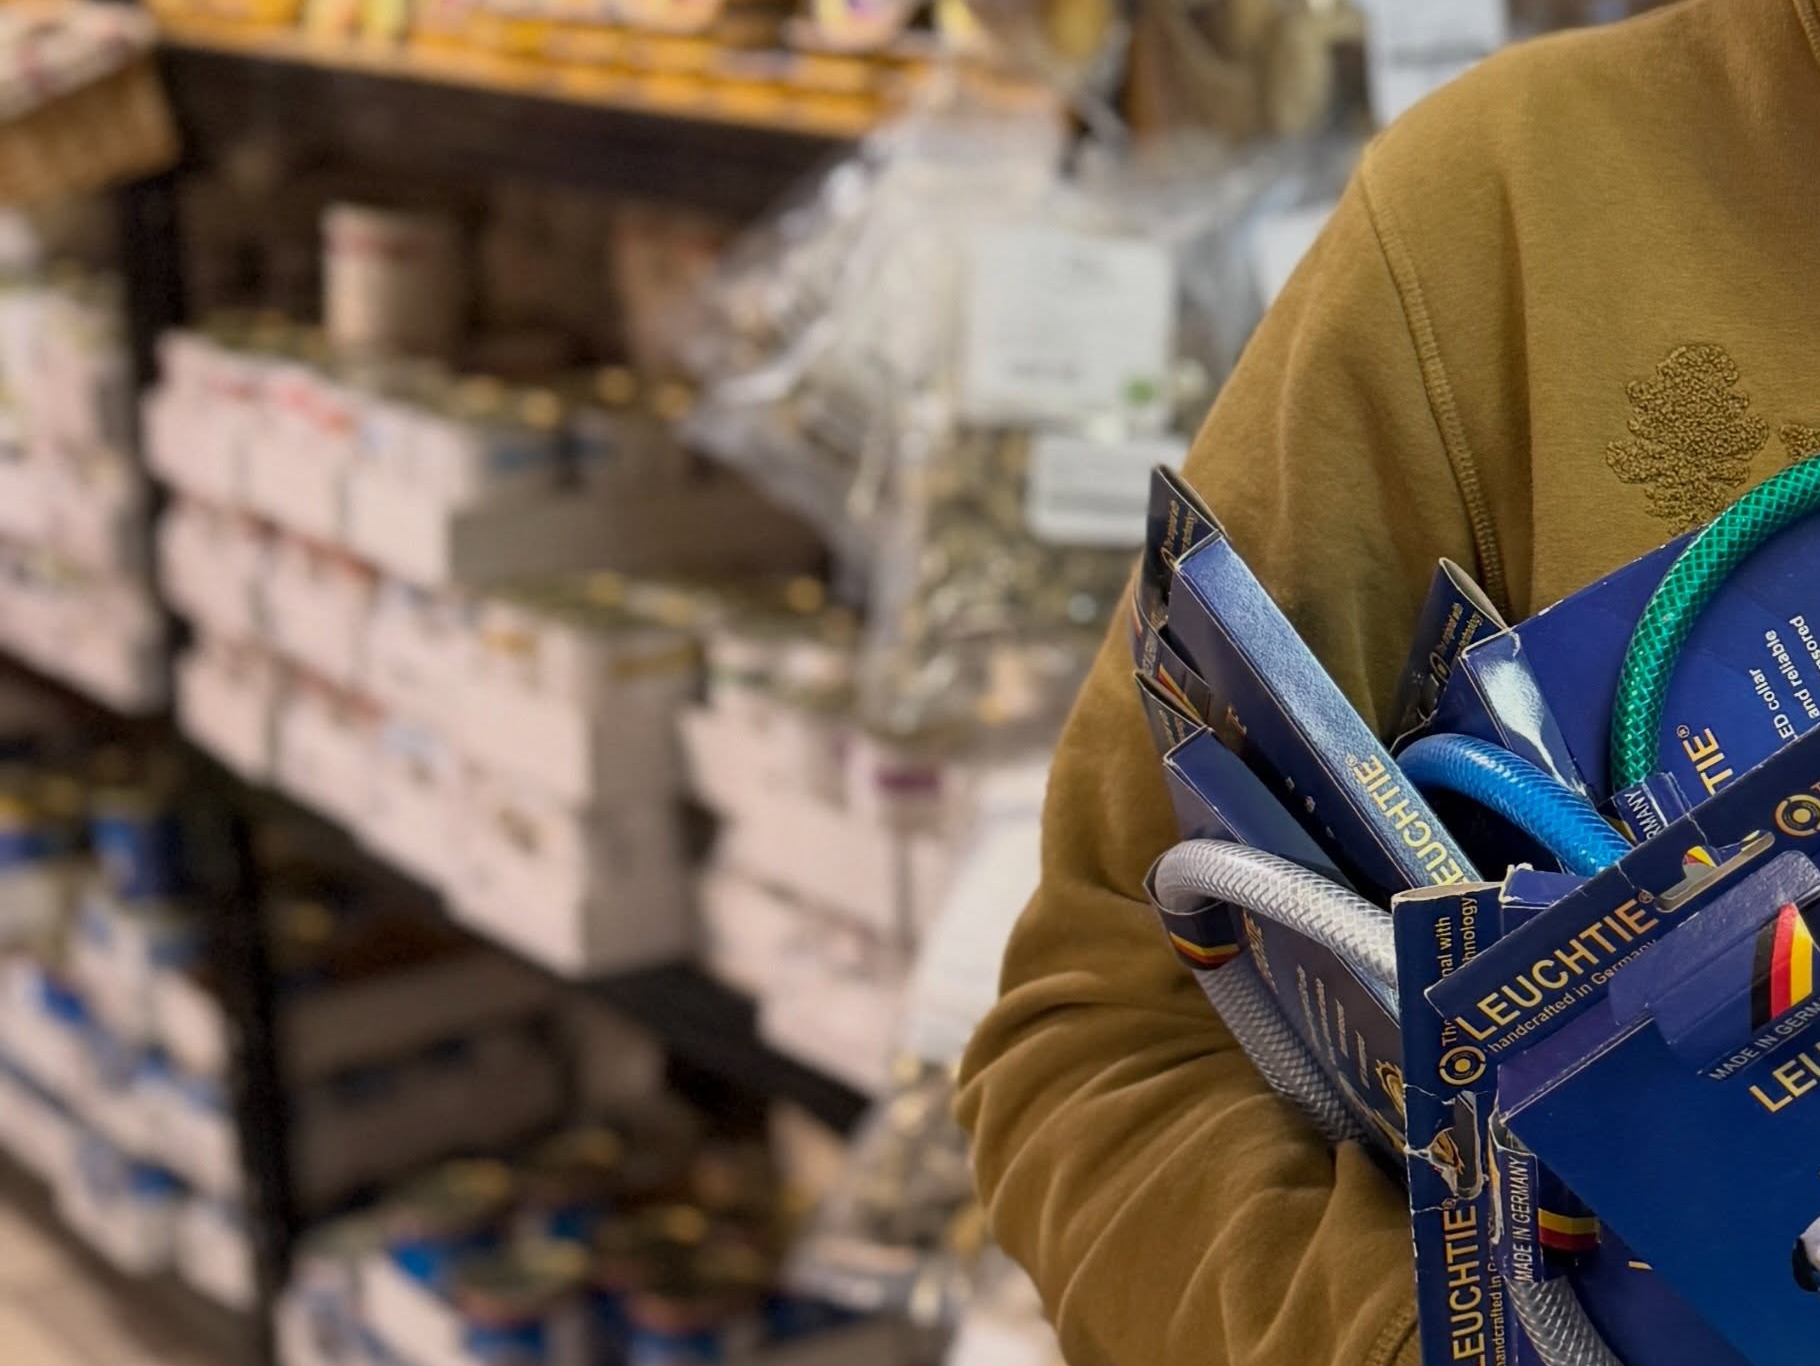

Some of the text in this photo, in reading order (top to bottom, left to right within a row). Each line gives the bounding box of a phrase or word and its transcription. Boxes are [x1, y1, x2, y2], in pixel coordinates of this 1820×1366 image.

[1749, 669, 1780, 710] collar
[1765, 630, 1820, 719] and reliable
[1624, 790, 1662, 839] RMANY
[1435, 916, 1453, 950] with
[1460, 897, 1478, 962] hnology
[1487, 992, 1576, 1053] handcrafted
[1576, 982, 1593, 998] in
[1708, 1047, 1759, 1080] MADE
[1756, 1034, 1778, 1050] IN
[1509, 1156, 1534, 1284] MADE IN GERMANY
